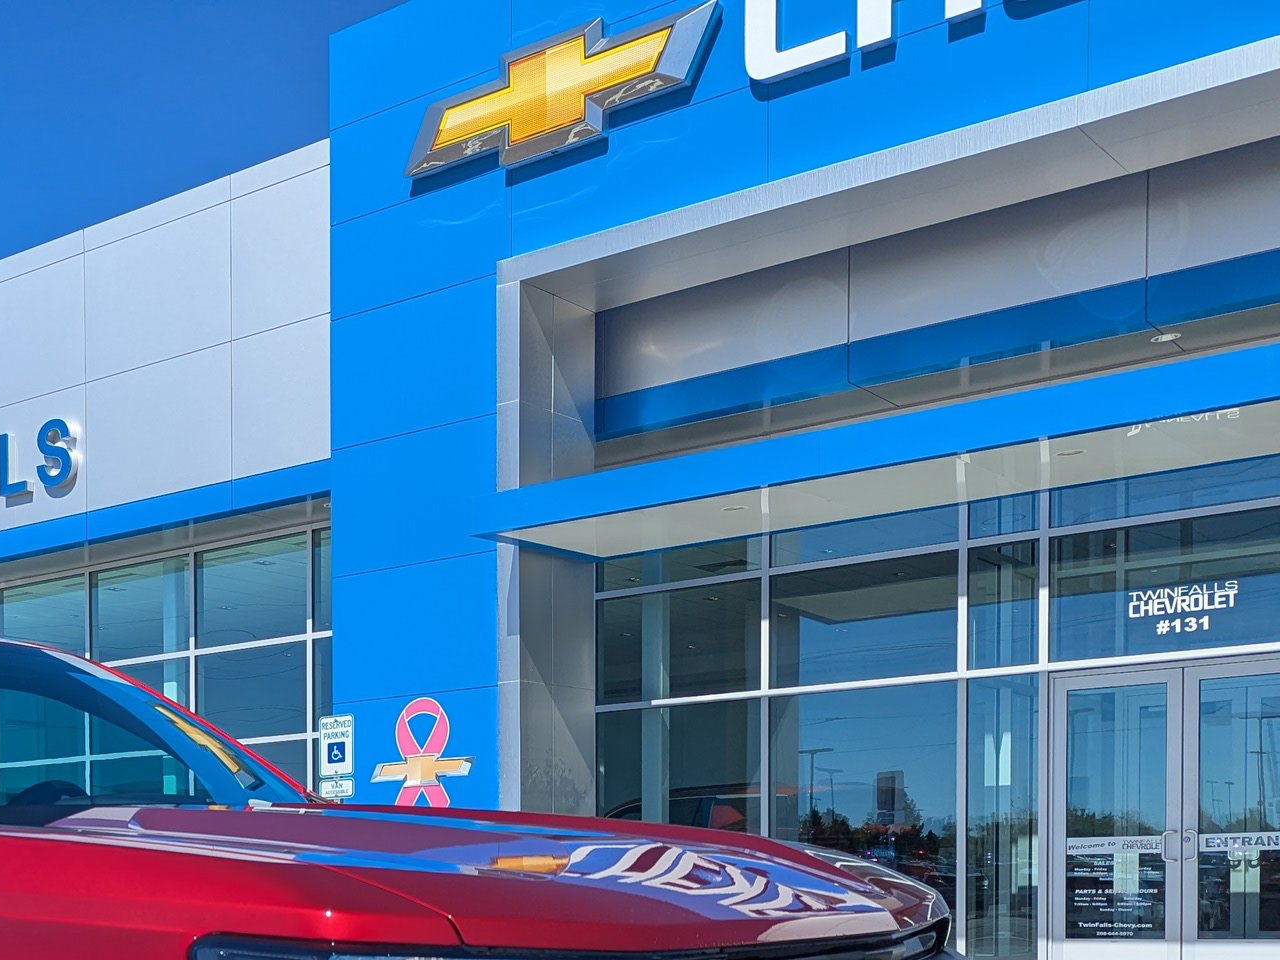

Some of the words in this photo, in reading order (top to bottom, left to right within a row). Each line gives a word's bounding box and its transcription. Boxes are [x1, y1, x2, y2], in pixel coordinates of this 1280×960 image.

[1128, 580, 1238, 602] TWINFALLS
[1128, 590, 1238, 618] CHEVROLET
[1156, 615, 1209, 635] #131
[321, 720, 352, 730] RESERVED
[323, 730, 350, 740] PARKING
[1068, 842, 1106, 851] Welcome
